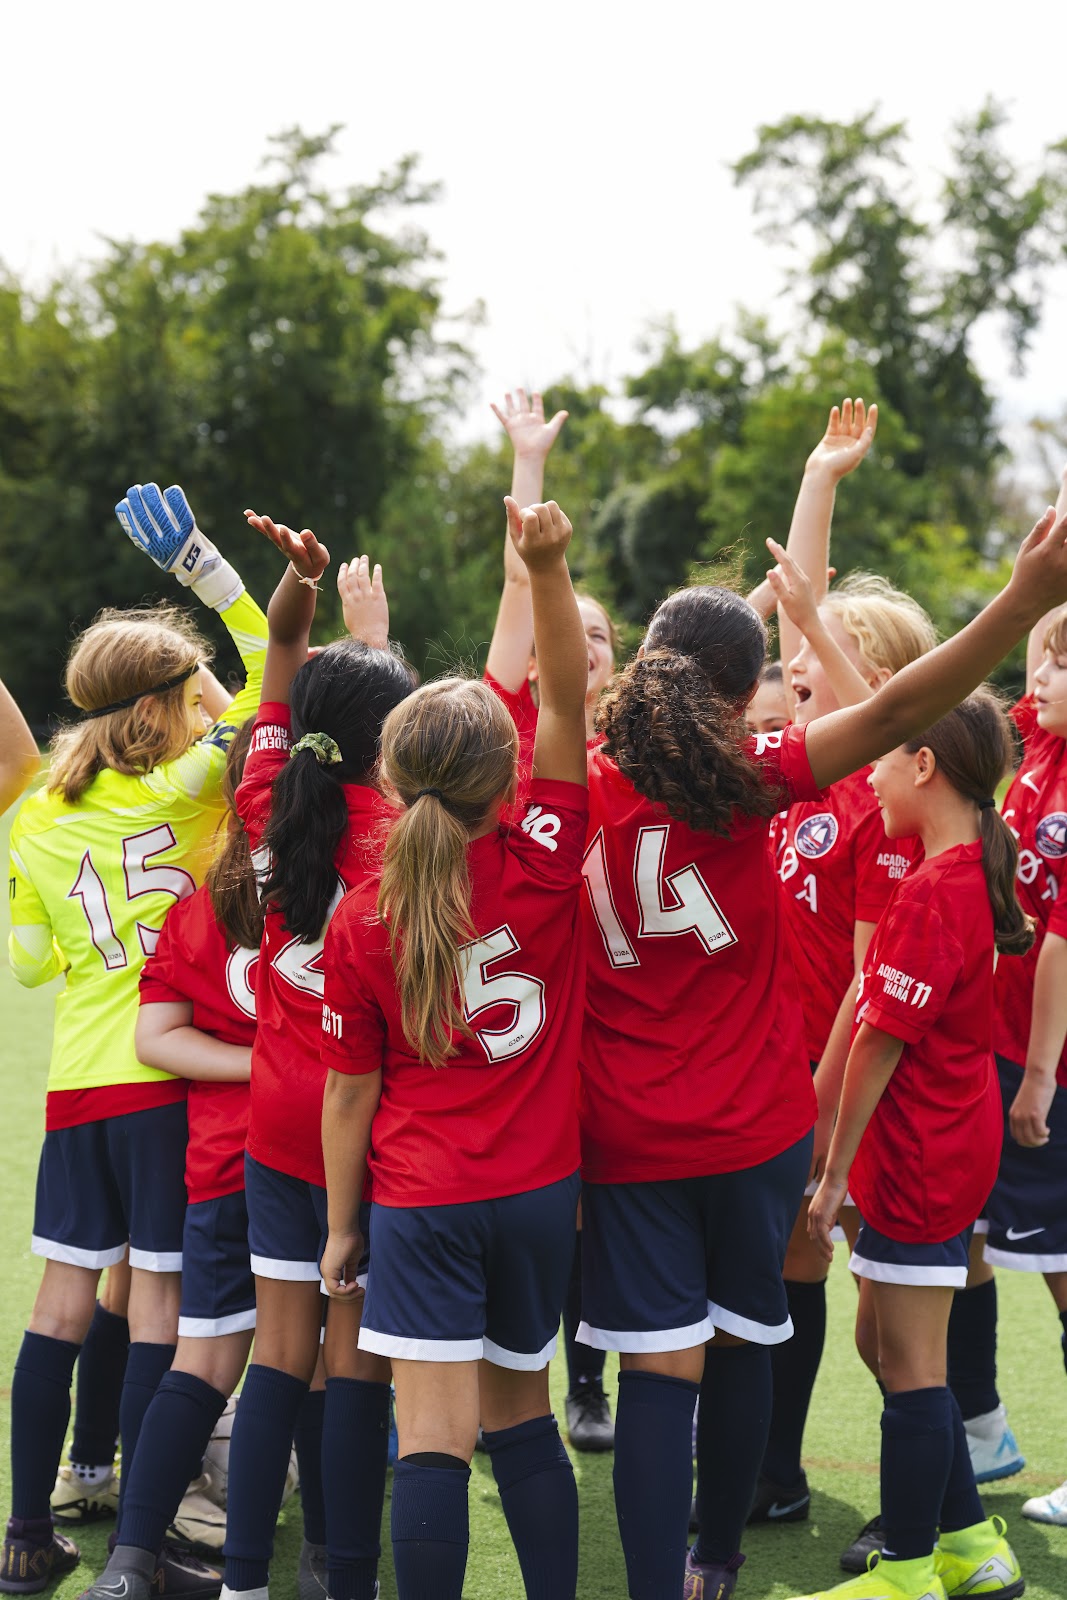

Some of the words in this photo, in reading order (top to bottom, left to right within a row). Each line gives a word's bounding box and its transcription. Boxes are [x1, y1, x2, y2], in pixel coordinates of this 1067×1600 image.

[66, 823, 196, 970] 15
[580, 824, 739, 969] 14
[330, 1011, 343, 1039] 11
[454, 923, 546, 1064] 5
[910, 981, 933, 1009] 11
